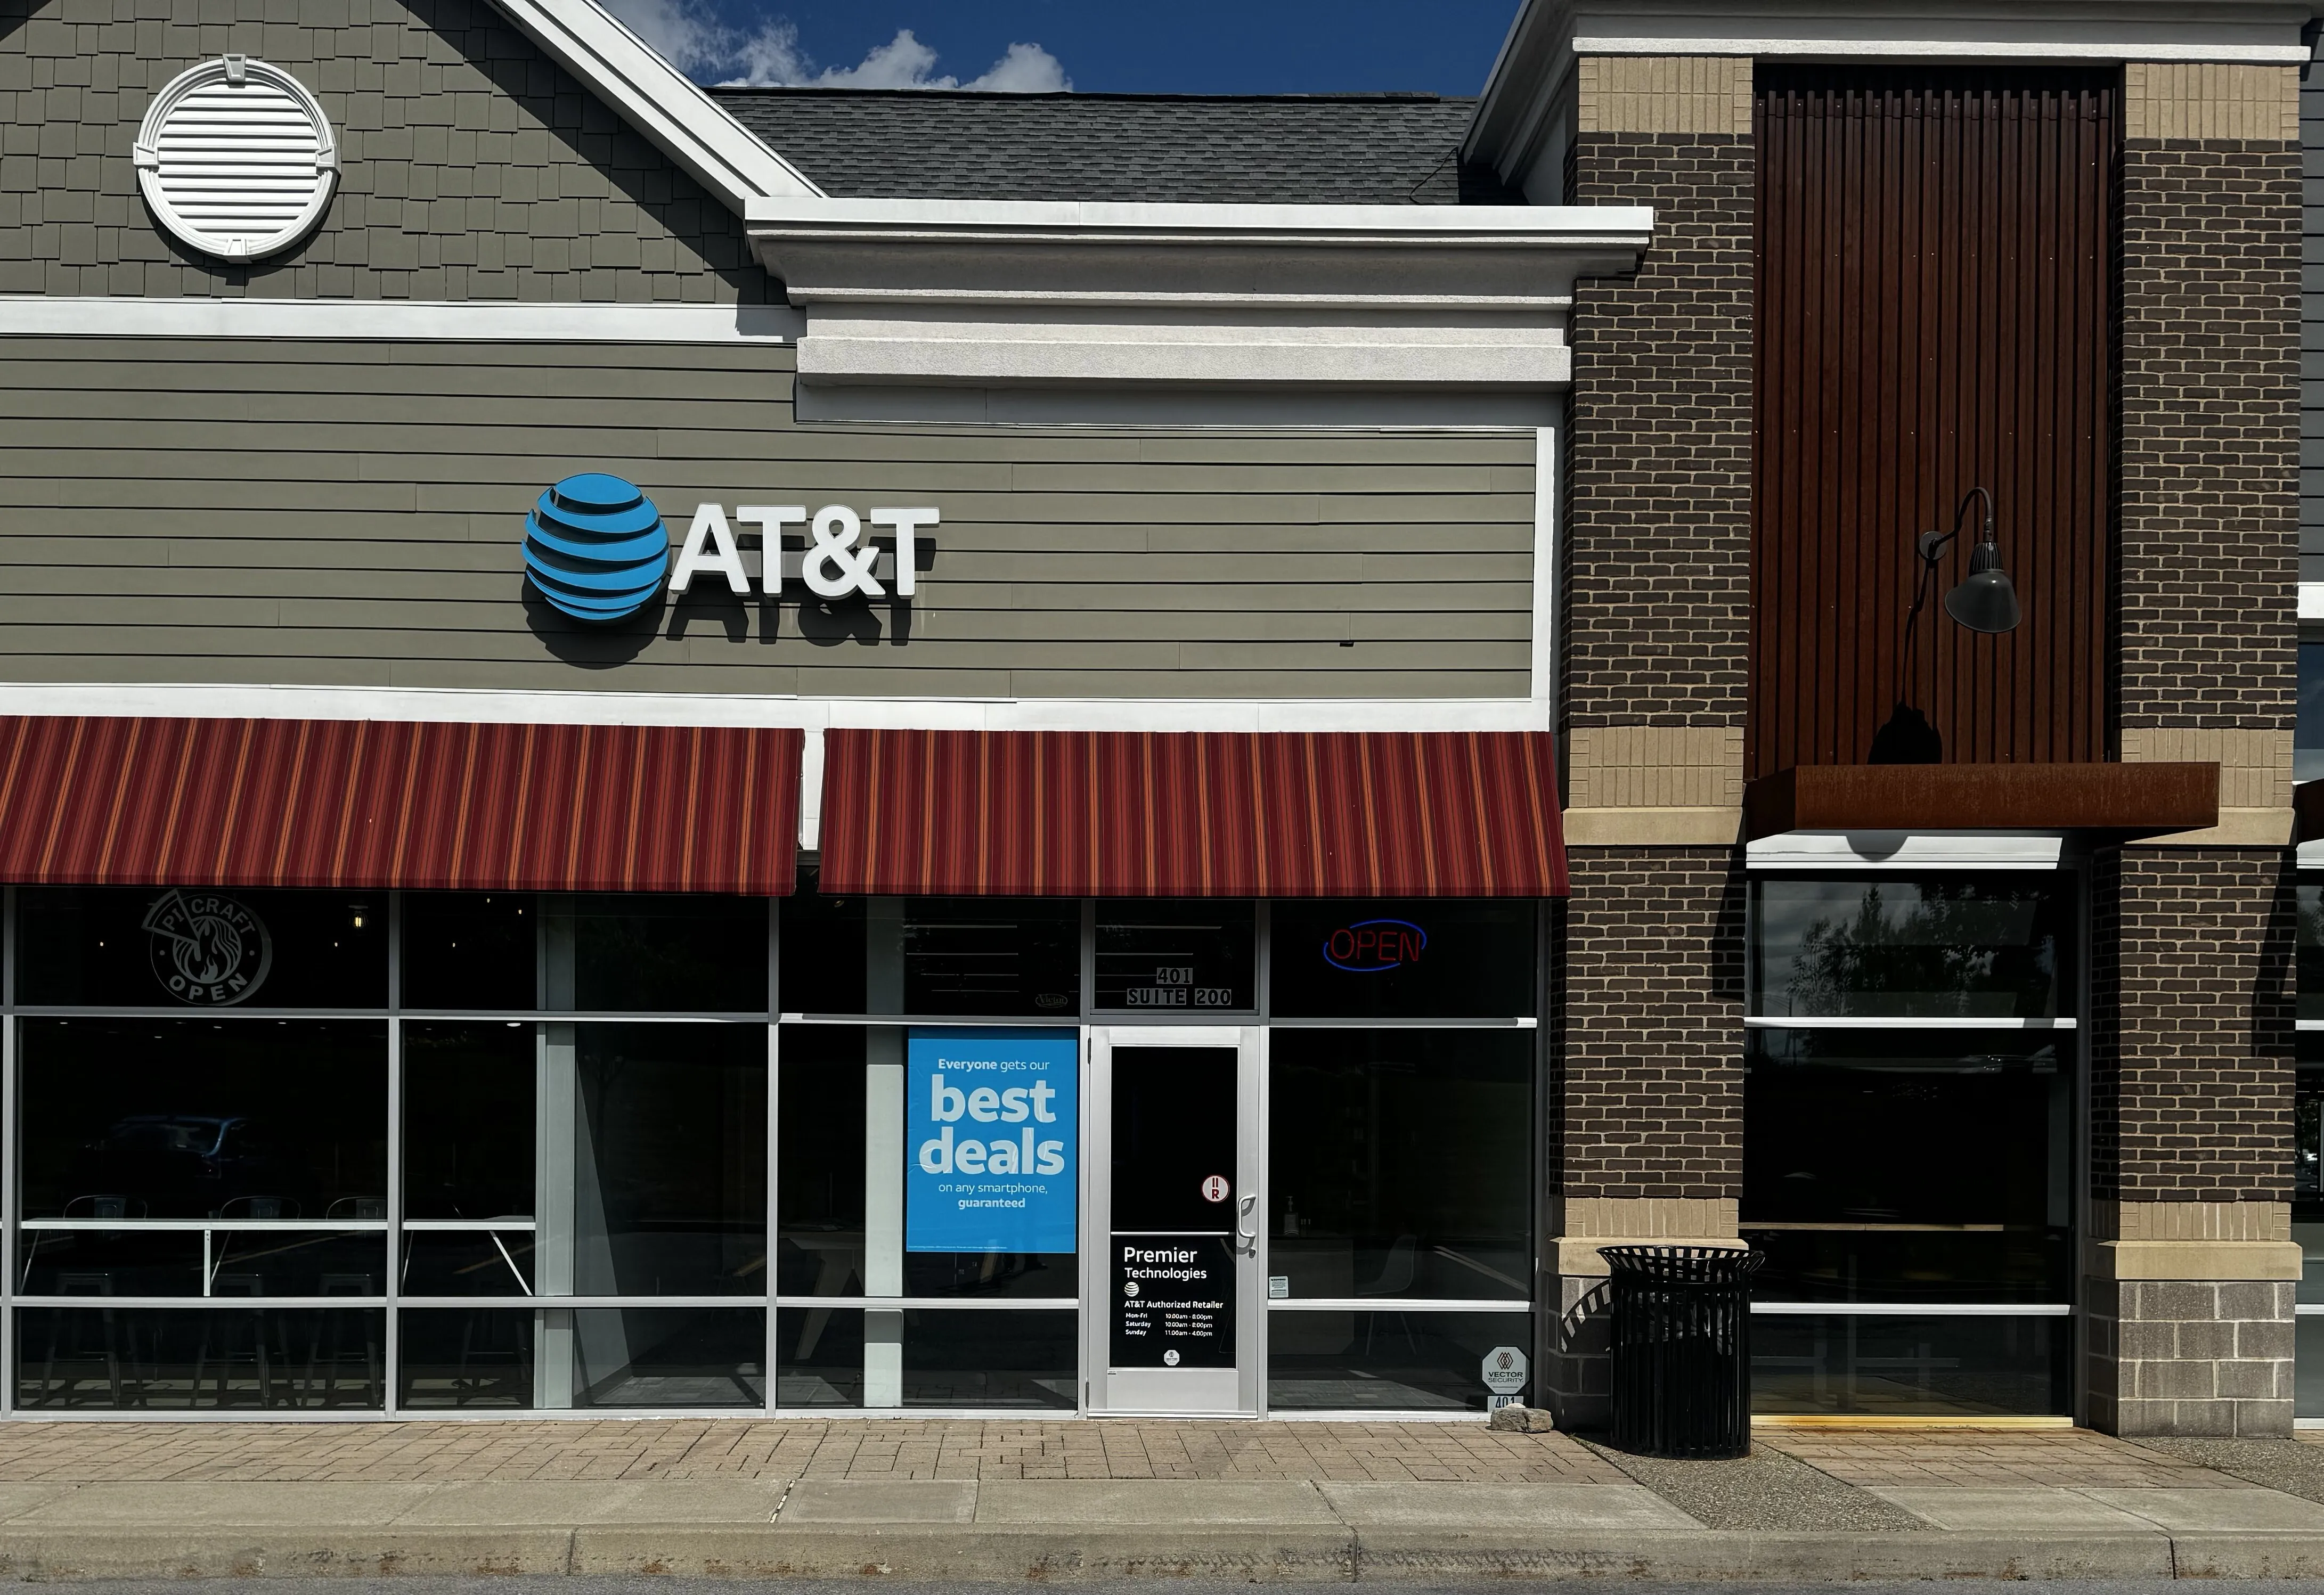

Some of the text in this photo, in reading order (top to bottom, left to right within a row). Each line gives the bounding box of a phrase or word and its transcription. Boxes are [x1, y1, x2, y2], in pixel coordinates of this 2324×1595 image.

[667, 502, 940, 600] AT&T
[161, 898, 256, 934] PI CRAFT
[1330, 929, 1420, 961] OPEN
[1157, 968, 1190, 984] 401
[169, 972, 248, 1001] OPEN
[1128, 988, 1231, 1005] SUITE 200
[938, 1058, 1050, 1073] Everyone gets our
[931, 1074, 1057, 1123] best
[919, 1126, 1065, 1175] deals
[939, 1182, 1048, 1195] on any smartphone,
[1212, 1189, 1219, 1199] R
[958, 1198, 1026, 1209] guaranteed
[1124, 1247, 1197, 1263] Premier
[1124, 1267, 1207, 1281] Technologies
[1495, 1396, 1515, 1408] 401
